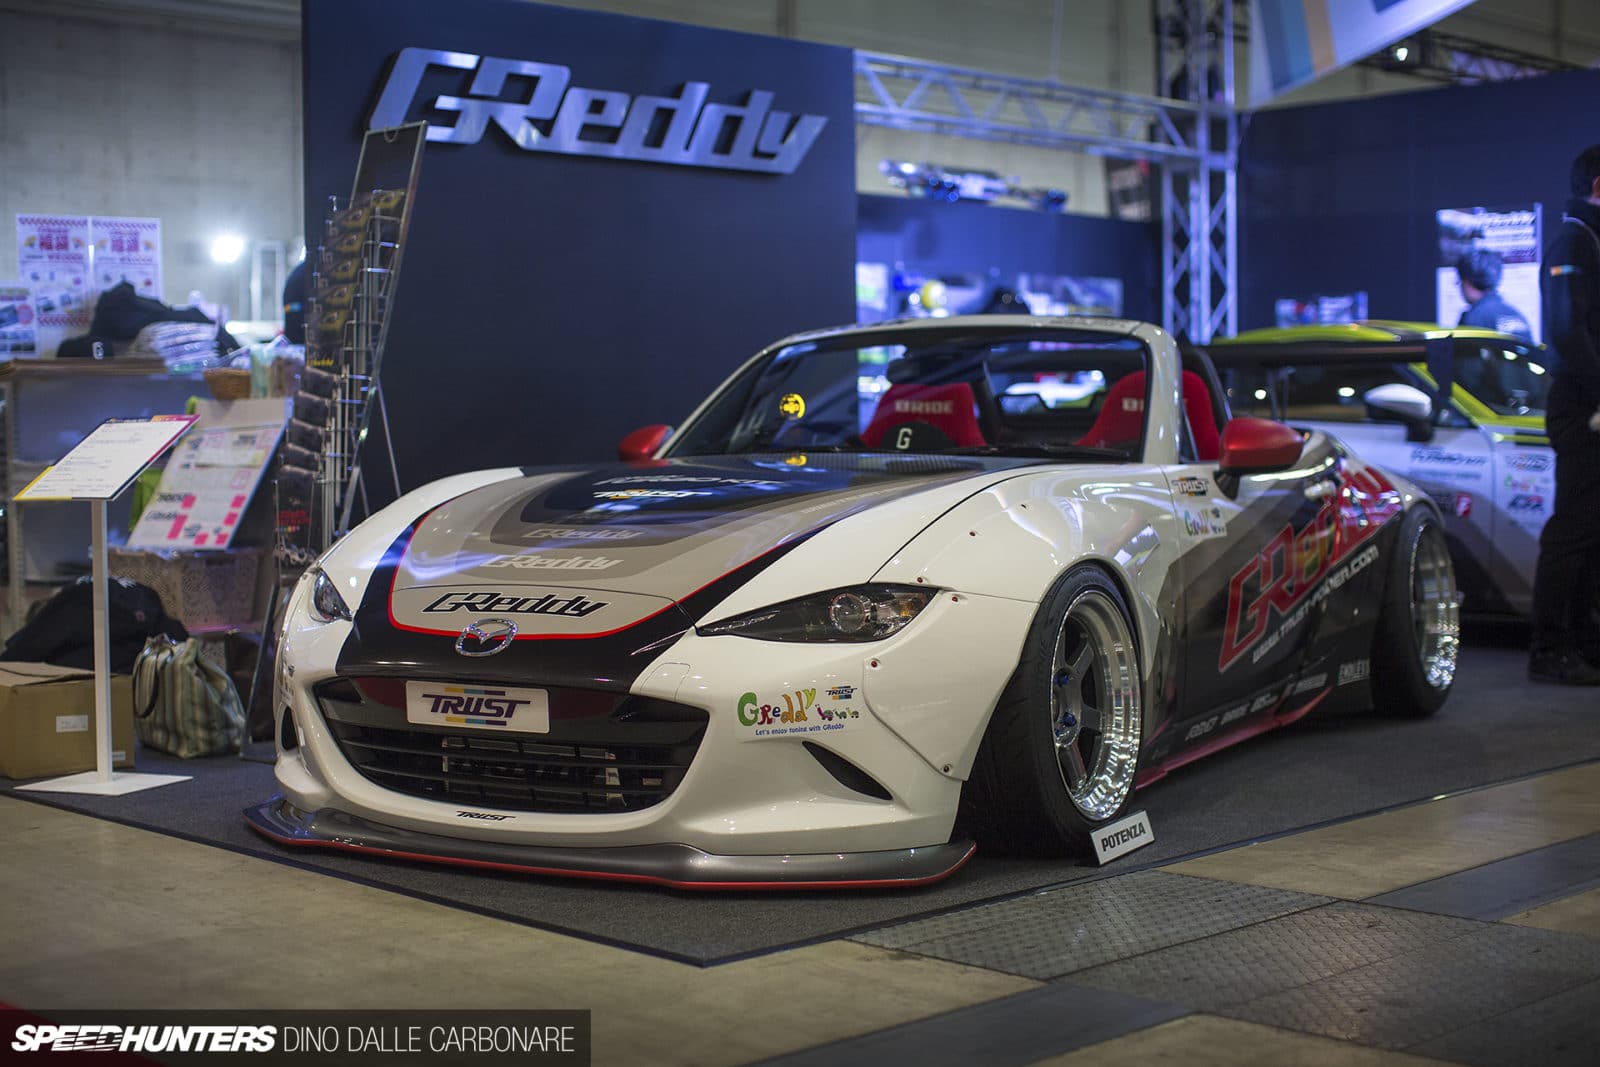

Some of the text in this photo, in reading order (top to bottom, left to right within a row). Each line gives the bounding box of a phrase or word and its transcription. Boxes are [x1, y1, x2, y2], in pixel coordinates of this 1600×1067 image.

[896, 428, 912, 449] G
[480, 554, 625, 570] GReddy
[421, 591, 613, 618] GReddy
[825, 687, 858, 696] TRUST
[422, 694, 531, 718] TRUST
[755, 728, 770, 736] Let's
[456, 811, 516, 821] TRUST
[1101, 822, 1146, 852] POTENZA
